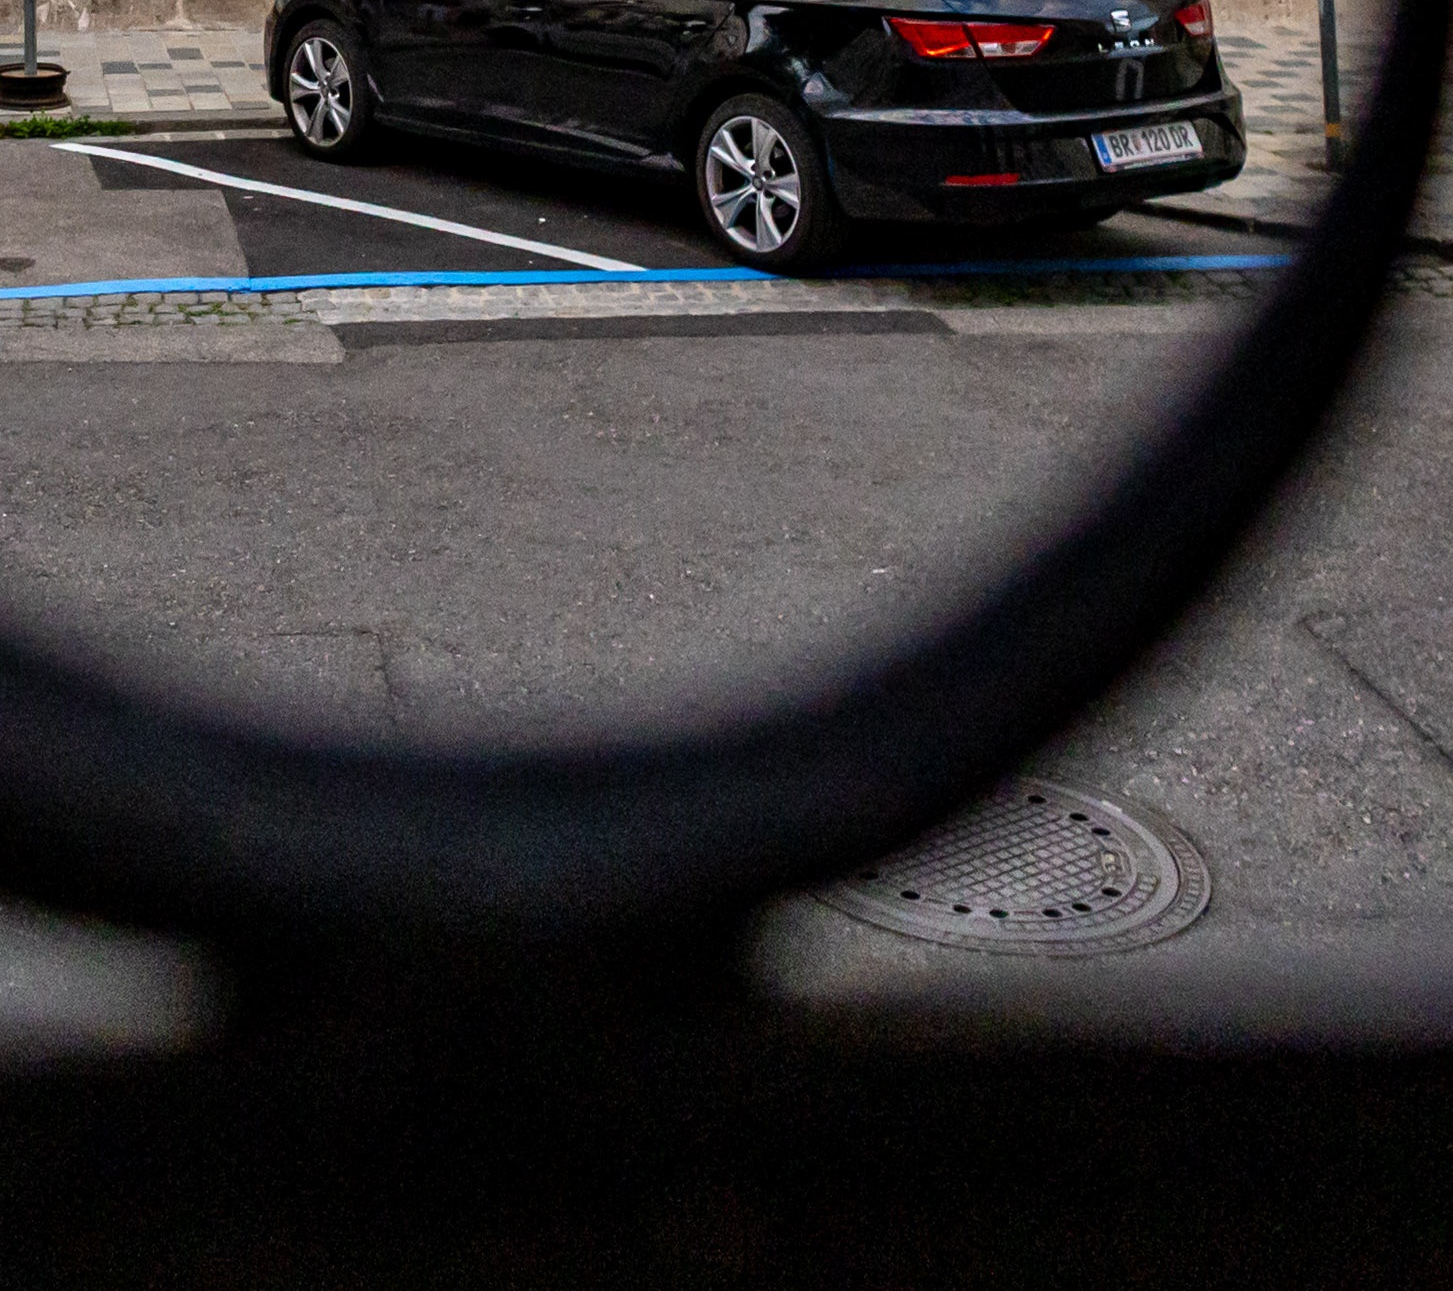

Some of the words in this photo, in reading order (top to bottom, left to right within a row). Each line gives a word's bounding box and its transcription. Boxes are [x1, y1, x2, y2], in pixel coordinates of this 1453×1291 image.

[1097, 38, 1155, 53] LEON
[1110, 135, 1134, 158] BR
[1142, 127, 1171, 152] 120
[1171, 124, 1194, 148] DR
